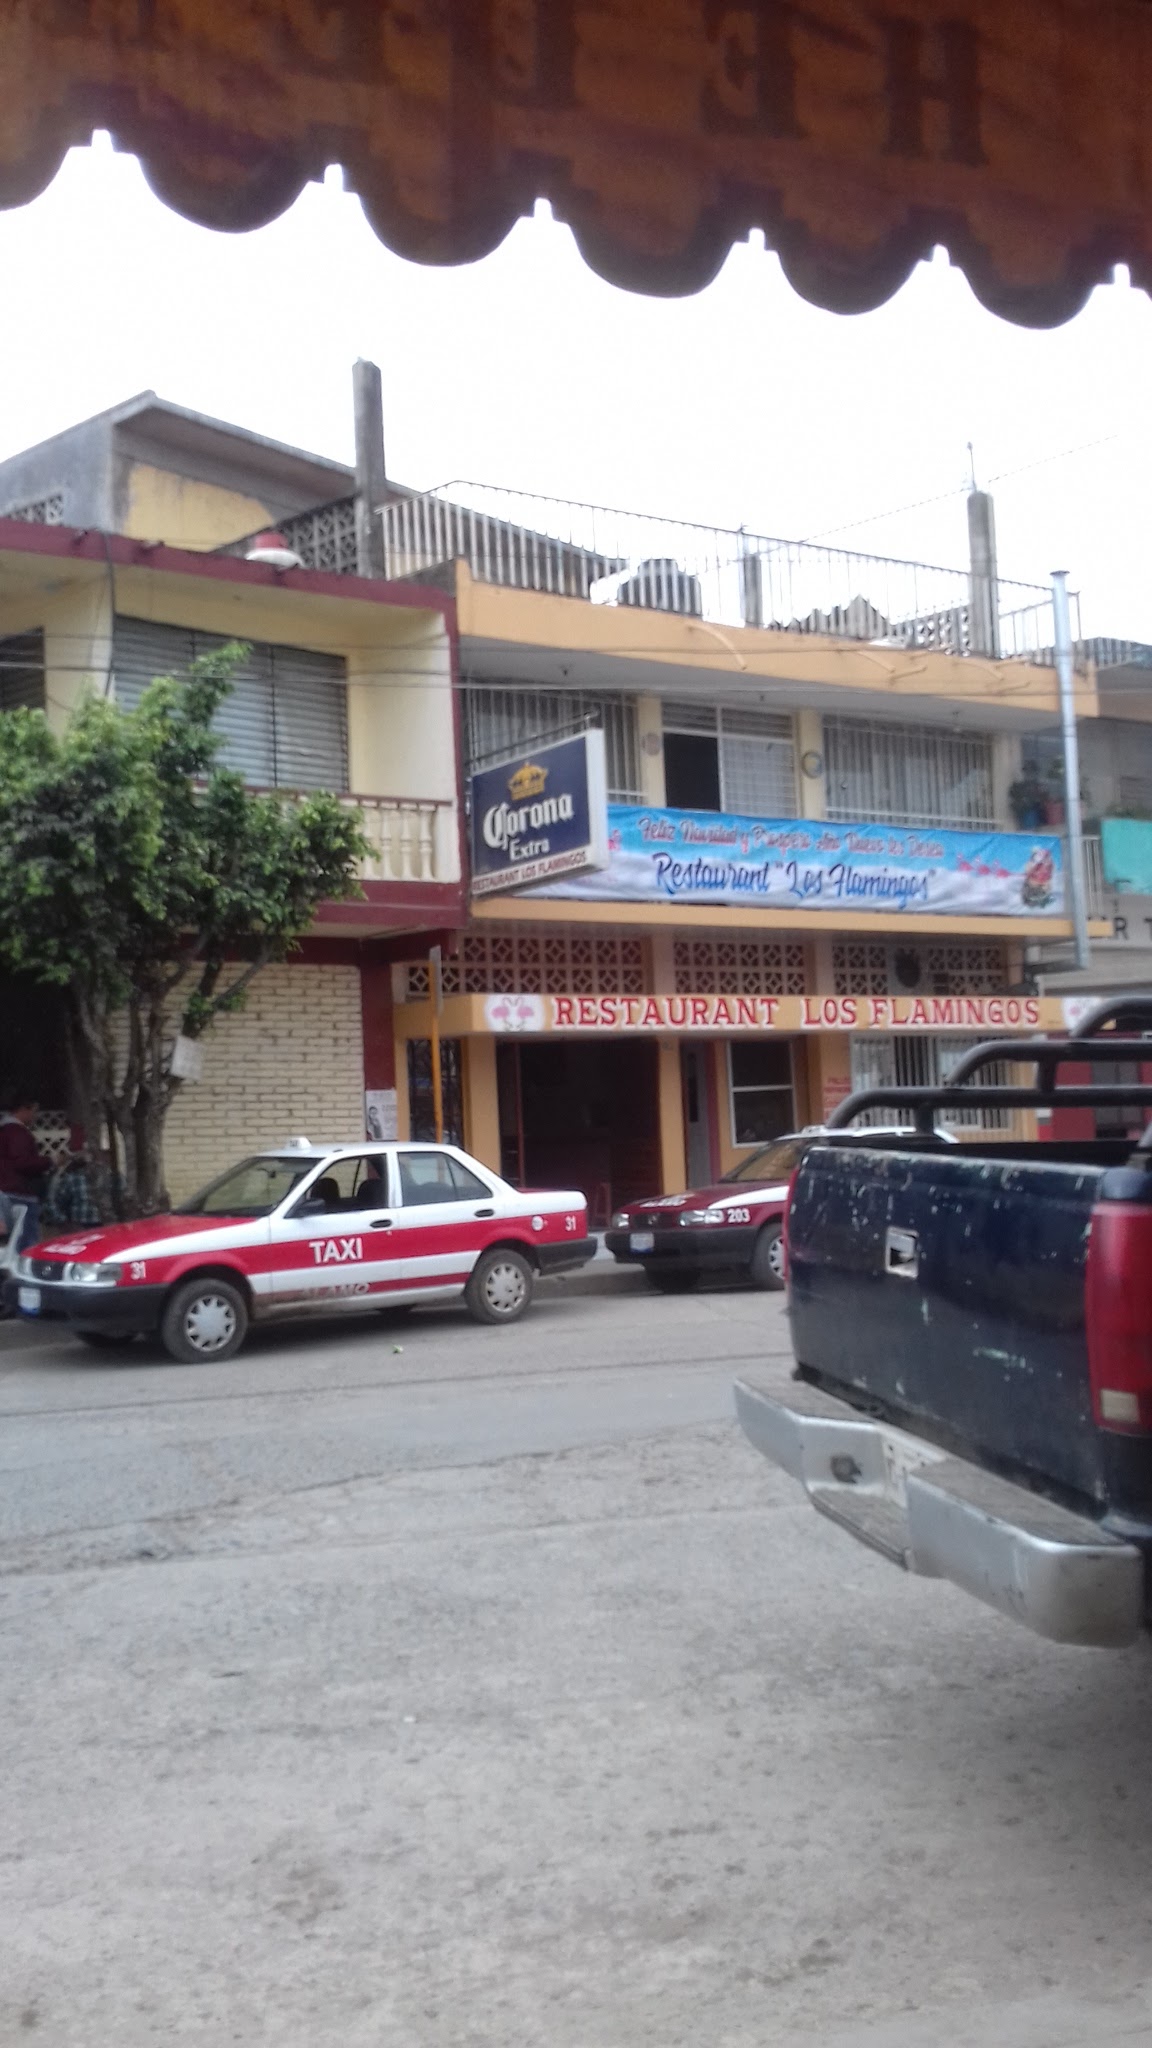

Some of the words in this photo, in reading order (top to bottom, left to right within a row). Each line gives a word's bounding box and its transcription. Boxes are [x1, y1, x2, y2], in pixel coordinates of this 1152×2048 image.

[483, 794, 575, 851] Corona
[639, 816, 676, 841] Feliz
[510, 838, 550, 861] Extra
[521, 864, 537, 879] LOS
[538, 851, 586, 874] FLAMINGOS
[652, 852, 769, 895] Restaurant
[553, 997, 779, 1027] RESTAURANT
[802, 998, 858, 1027] LOS
[869, 998, 1040, 1027] FLAMINGOS
[565, 1215, 577, 1231] 31
[728, 1208, 750, 1223] 203
[309, 1236, 364, 1264] TAXI
[130, 1261, 146, 1280] 31
